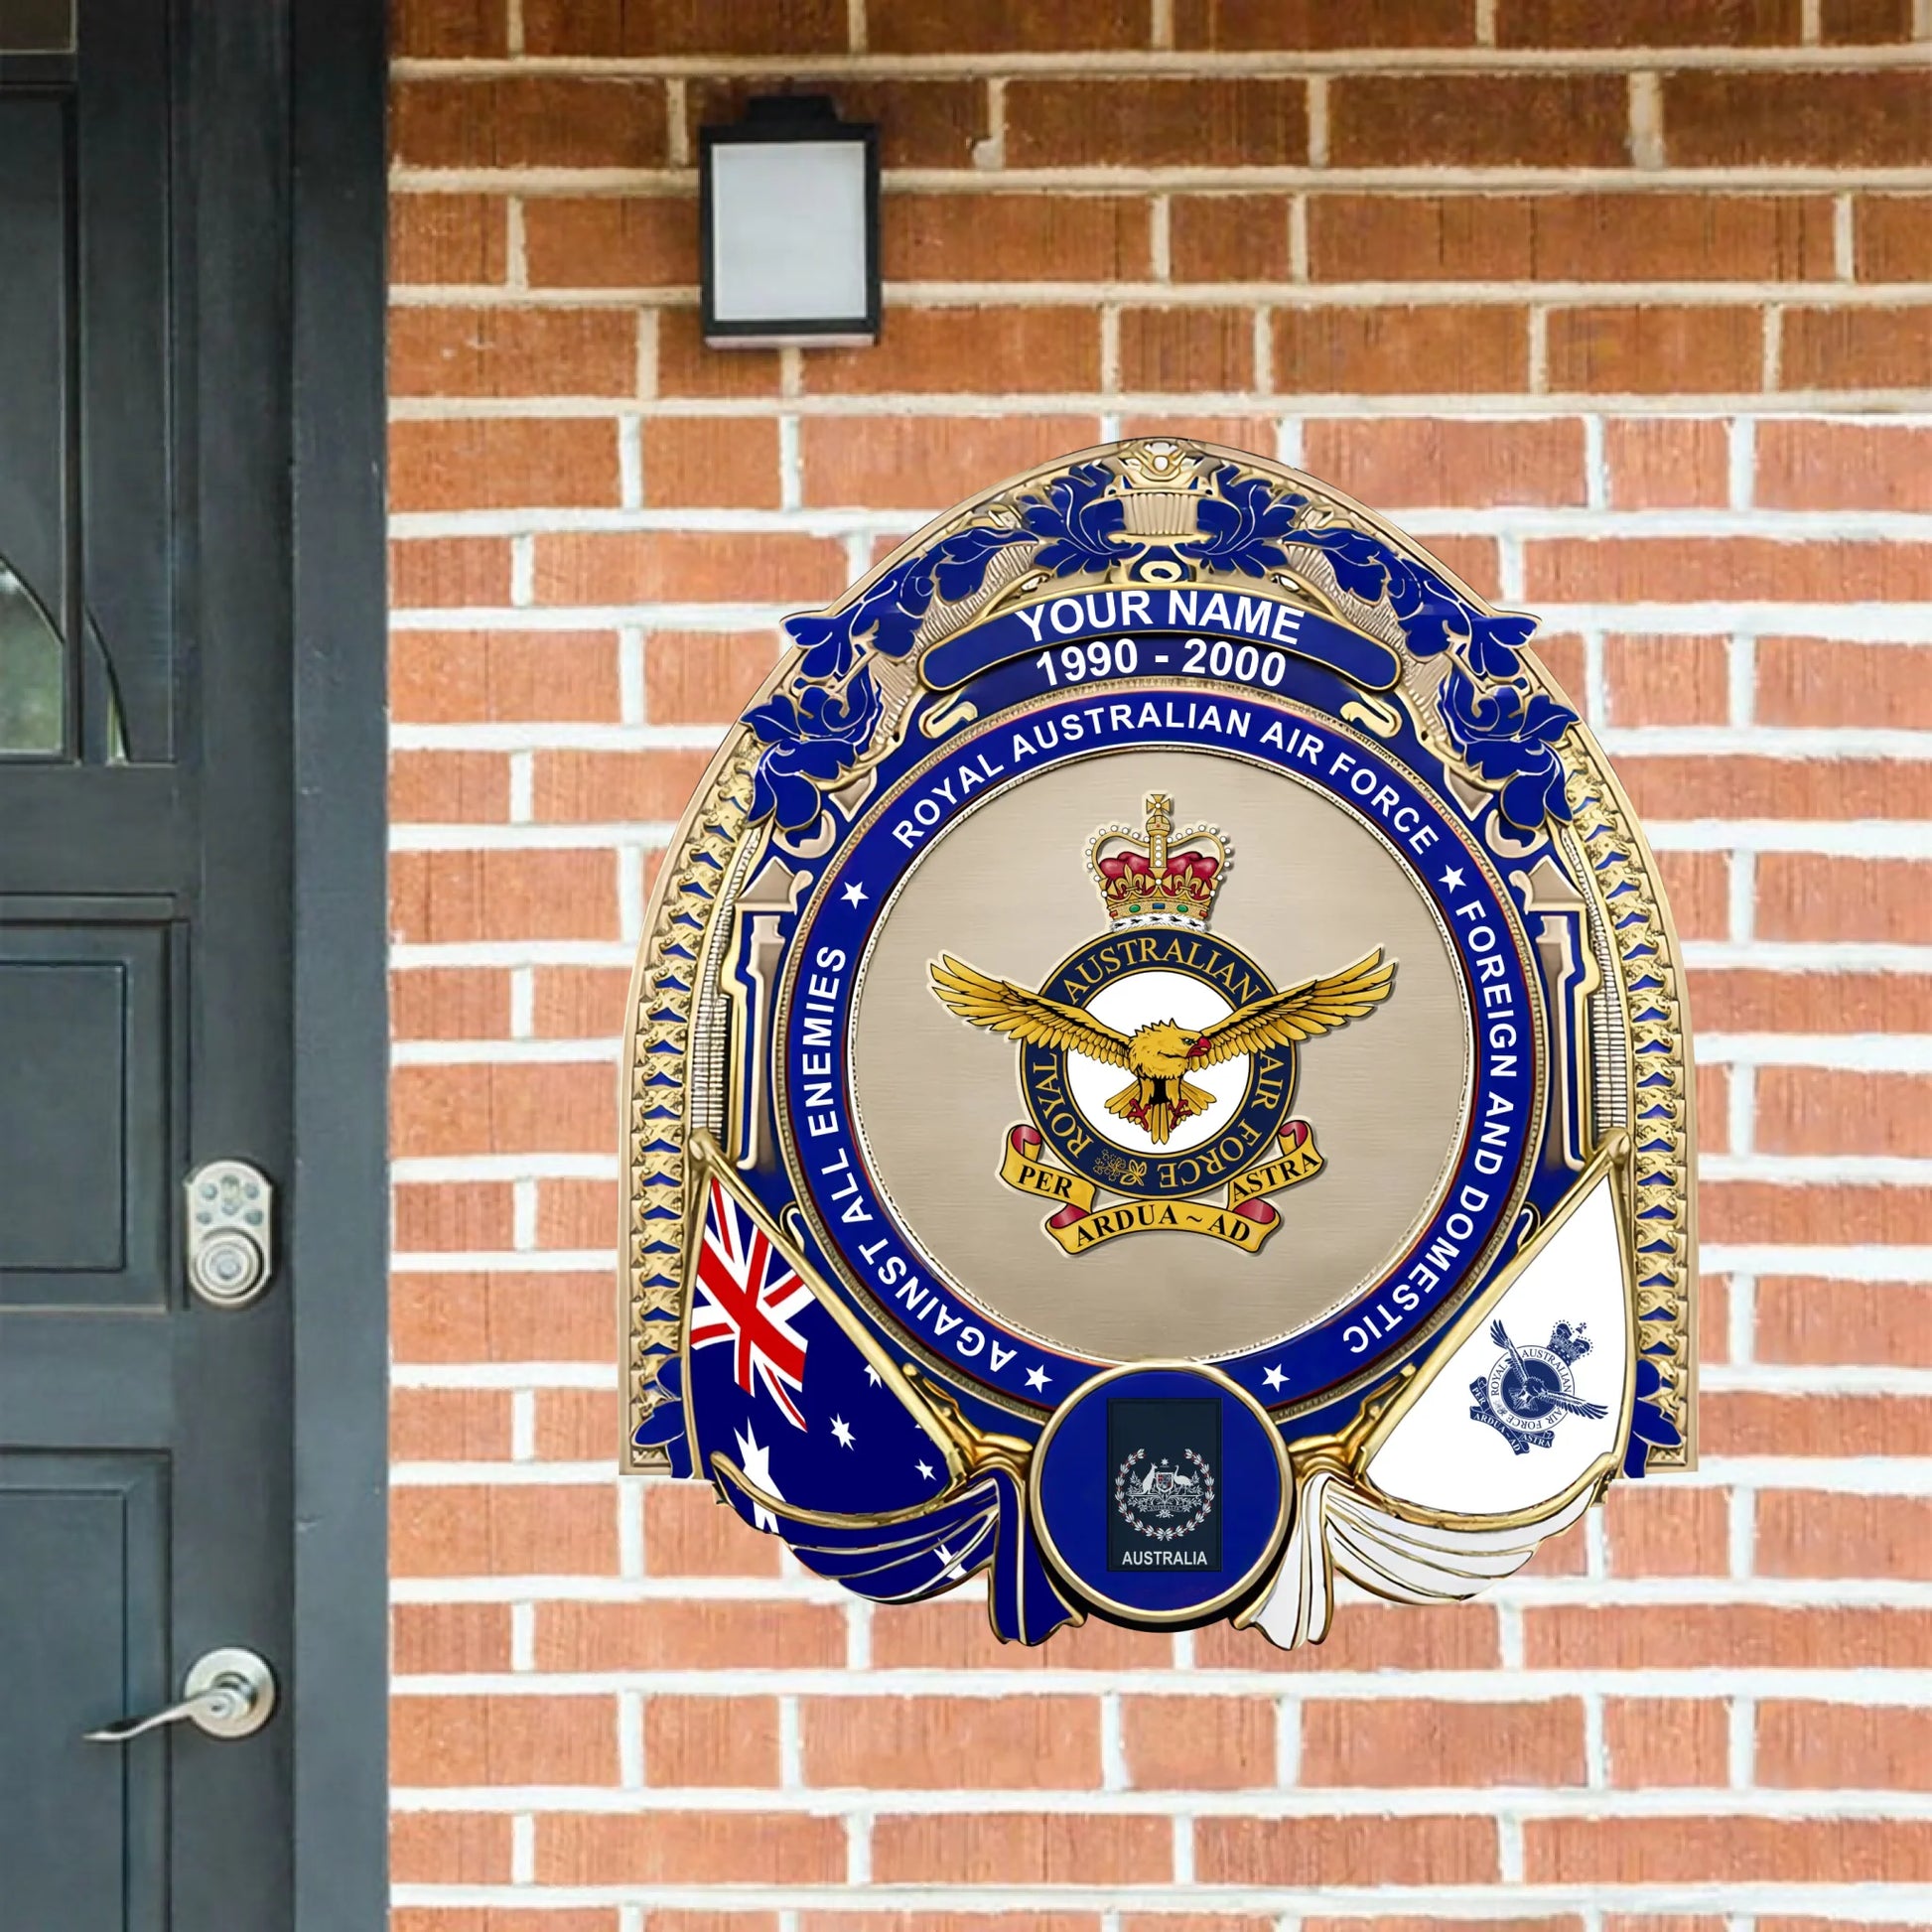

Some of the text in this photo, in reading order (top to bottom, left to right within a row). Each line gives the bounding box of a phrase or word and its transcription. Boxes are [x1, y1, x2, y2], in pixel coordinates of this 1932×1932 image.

[1016, 590, 1305, 645] YOUR NAME
[1036, 639, 1138, 686] 1990
[1183, 639, 1287, 687] 2000
[893, 703, 1440, 856] ROYAL AUSTRALIAN AIR FORCE
[1034, 937, 1285, 1188] ROYAL AUSTRALIAN AIR FORCE
[1342, 899, 1517, 1353] FOREIGN AND DOMESTIC
[802, 945, 1018, 1373] AGAINST ALL ENEMIES
[1018, 1165, 1073, 1198] PER
[1077, 1205, 1177, 1247] ARDUA
[1207, 1214, 1251, 1244] AD
[1231, 1153, 1320, 1202] ASTRA
[1472, 1387, 1486, 1405] PER
[1491, 1348, 1572, 1430] ROYAL AUSTRALIAN AIR FORCE
[1473, 1413, 1506, 1436] ARDUA
[1509, 1439, 1521, 1451] AD
[1521, 1433, 1552, 1448] ASTRA
[1122, 1551, 1208, 1566] AUSTRALIA
